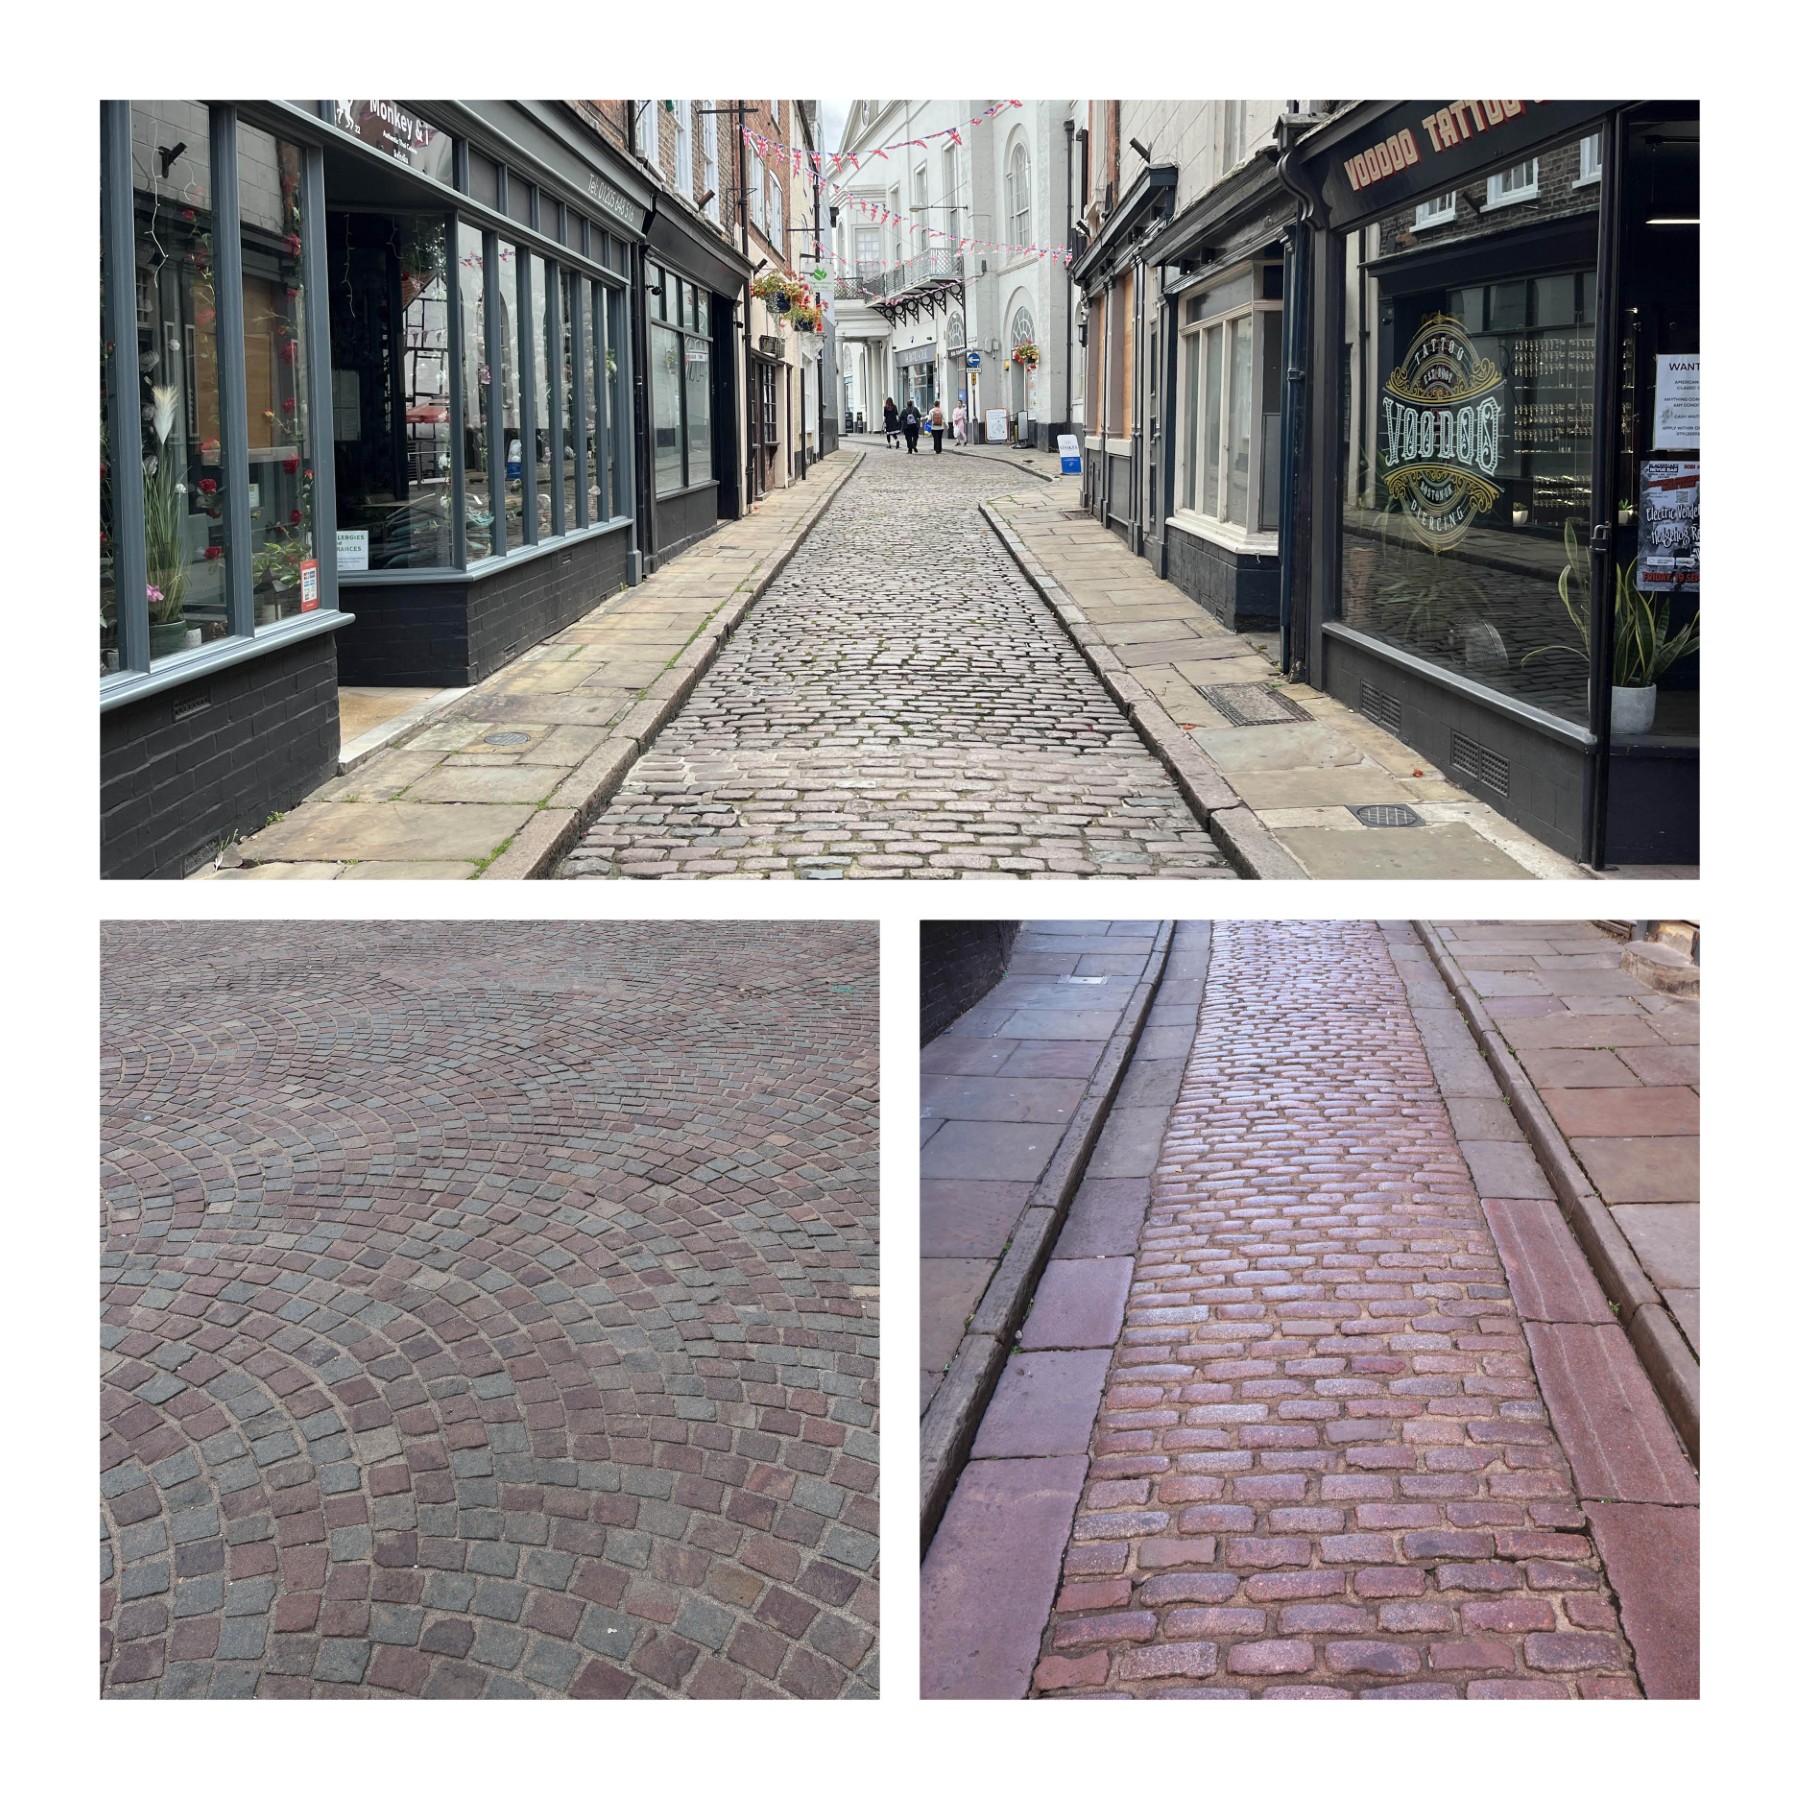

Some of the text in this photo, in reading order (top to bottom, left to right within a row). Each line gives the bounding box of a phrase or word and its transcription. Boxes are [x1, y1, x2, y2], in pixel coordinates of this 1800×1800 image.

[370, 100, 412, 140] Monkey
[415, 119, 423, 142] &
[1344, 128, 1421, 192] VOODOO
[1415, 337, 1464, 365] TATTOO
[1383, 396, 1501, 477] VOODOO
[1411, 499, 1463, 532] PIERCING
[1646, 506, 1675, 522] Electric
